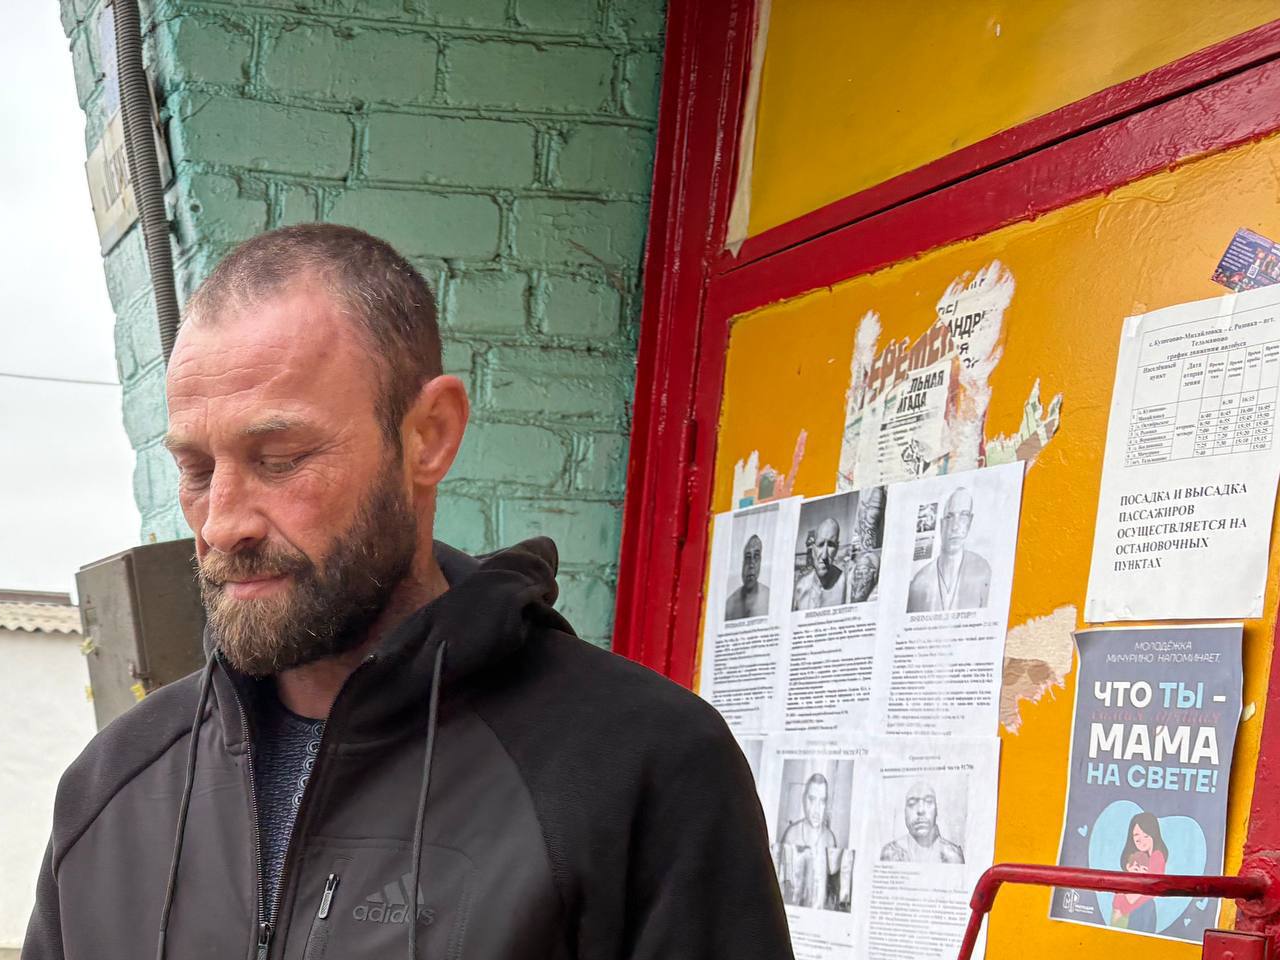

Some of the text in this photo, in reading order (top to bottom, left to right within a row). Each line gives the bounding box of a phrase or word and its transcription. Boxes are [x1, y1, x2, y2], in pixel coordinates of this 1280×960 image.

[1120, 483, 1247, 506] ПОСАДКА И ВЫСАДКА
[1118, 504, 1195, 523] ПАССАЖИРОВ
[1117, 517, 1247, 539] ОСУЩЕСТВЛЯЕТСЯ НА
[1115, 537, 1209, 556] ОСТАНОВОЧНЫХ
[1113, 557, 1162, 571] ПУНКТАХ
[1134, 640, 1192, 651] МОЛОДЁЖКА
[1106, 653, 1154, 663] МИЧУРИНО
[1094, 681, 1153, 708] ЧТО
[1158, 682, 1204, 709] ТЫ
[1088, 722, 1219, 765] МАМА
[1086, 762, 1218, 794] НА СВЕТЕ!
